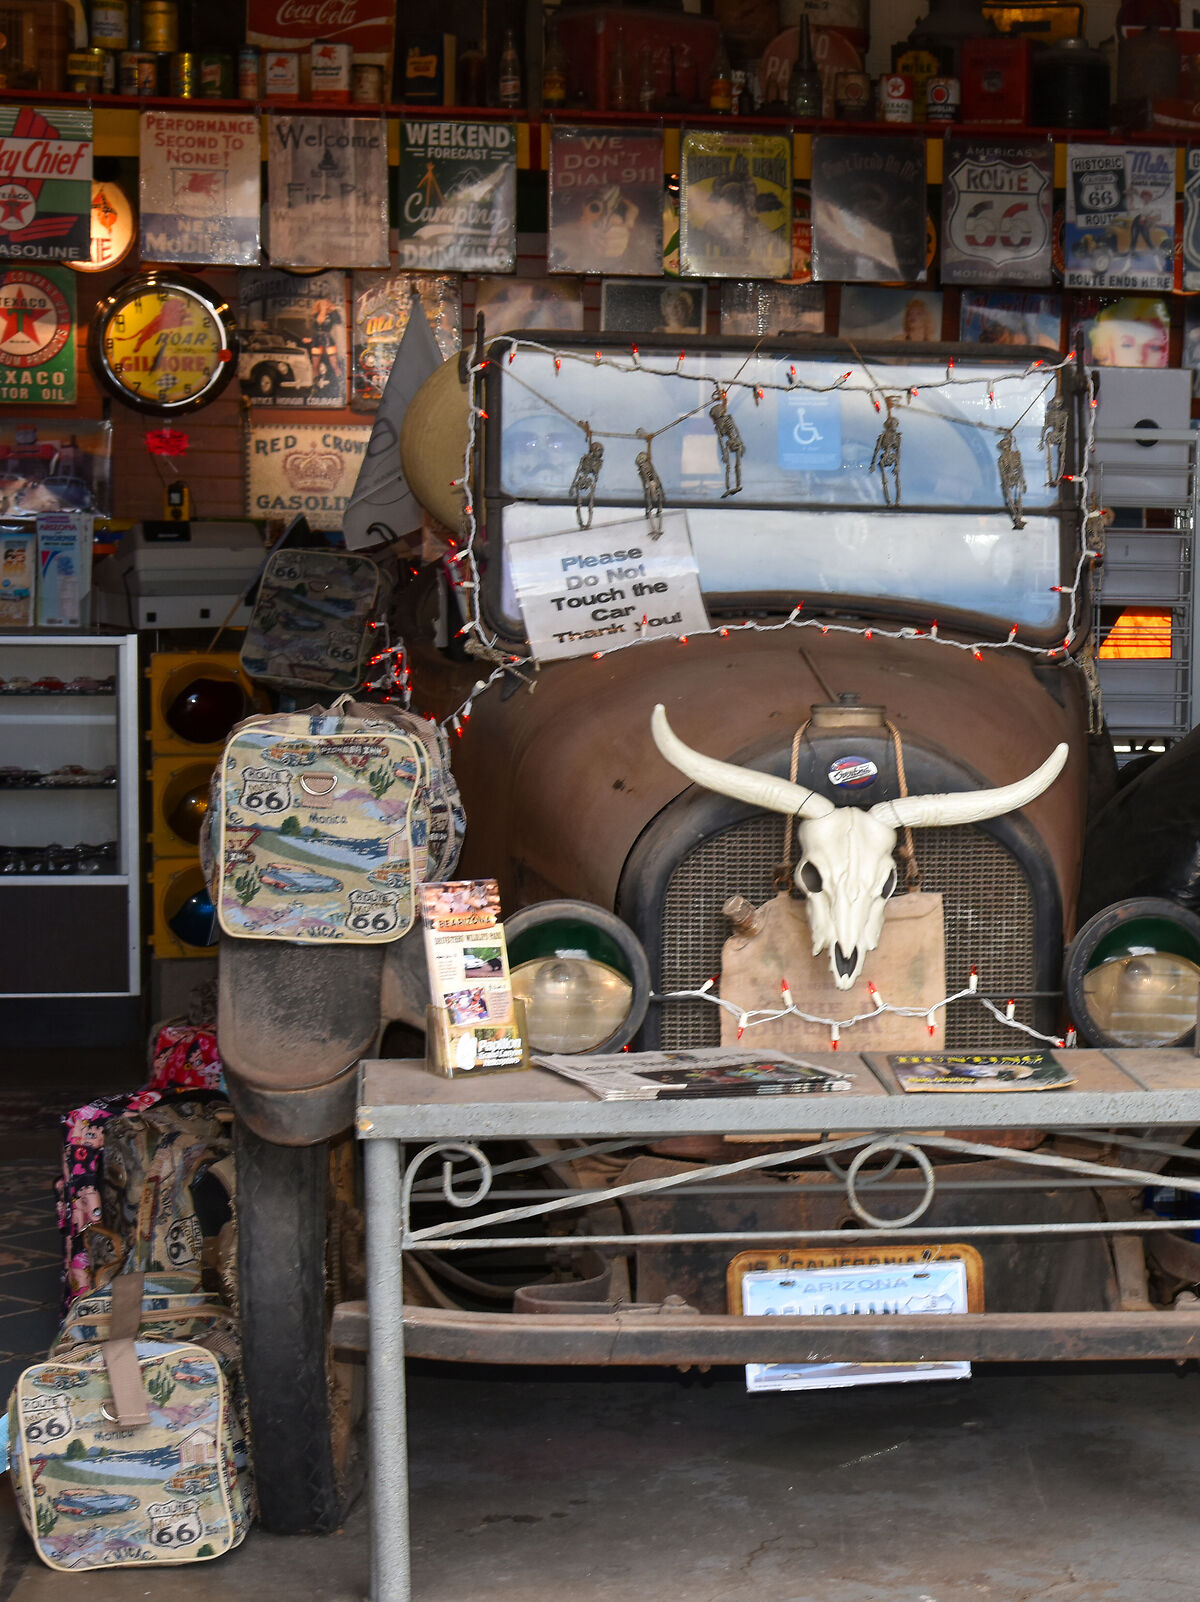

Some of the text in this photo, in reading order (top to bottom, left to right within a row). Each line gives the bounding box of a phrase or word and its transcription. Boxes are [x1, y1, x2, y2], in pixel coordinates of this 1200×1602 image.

[146, 115, 255, 135] PERFORMANCE
[154, 132, 218, 149] SECOND
[277, 123, 380, 149] Welcome
[406, 123, 511, 148] WEEKEND
[582, 136, 624, 150] WE
[22, 141, 89, 175] Chief
[427, 147, 488, 160] FORECAST
[563, 151, 641, 170] DON'T
[1074, 158, 1121, 170] HISTORIC
[621, 167, 655, 183] 911
[966, 167, 1029, 192] ROUTE
[1089, 191, 1113, 206] 66
[404, 192, 511, 236] Camping
[177, 220, 220, 232] NEW
[965, 201, 1033, 247] 66
[1069, 274, 1105, 286] ROUTE
[1109, 276, 1138, 287] ENDS
[156, 332, 209, 346] ROAR
[121, 356, 207, 373] GILMORE
[42, 389, 65, 400] OIL
[255, 435, 297, 456] RED
[561, 546, 643, 572] Please
[275, 567, 298, 579] 66
[566, 563, 647, 591] Do Not
[551, 580, 669, 611] Touch the
[591, 604, 636, 622] Car
[553, 623, 625, 644] Thank
[330, 647, 354, 660] 66
[246, 792, 283, 809] 66
[309, 814, 348, 825] Monica
[352, 913, 389, 931] 66
[802, 1277, 909, 1294] ARIZONA
[24, 1397, 58, 1409] ROUTE
[26, 1418, 65, 1441] 66
[154, 1502, 190, 1515] ROUTE
[156, 1523, 195, 1544] 66
